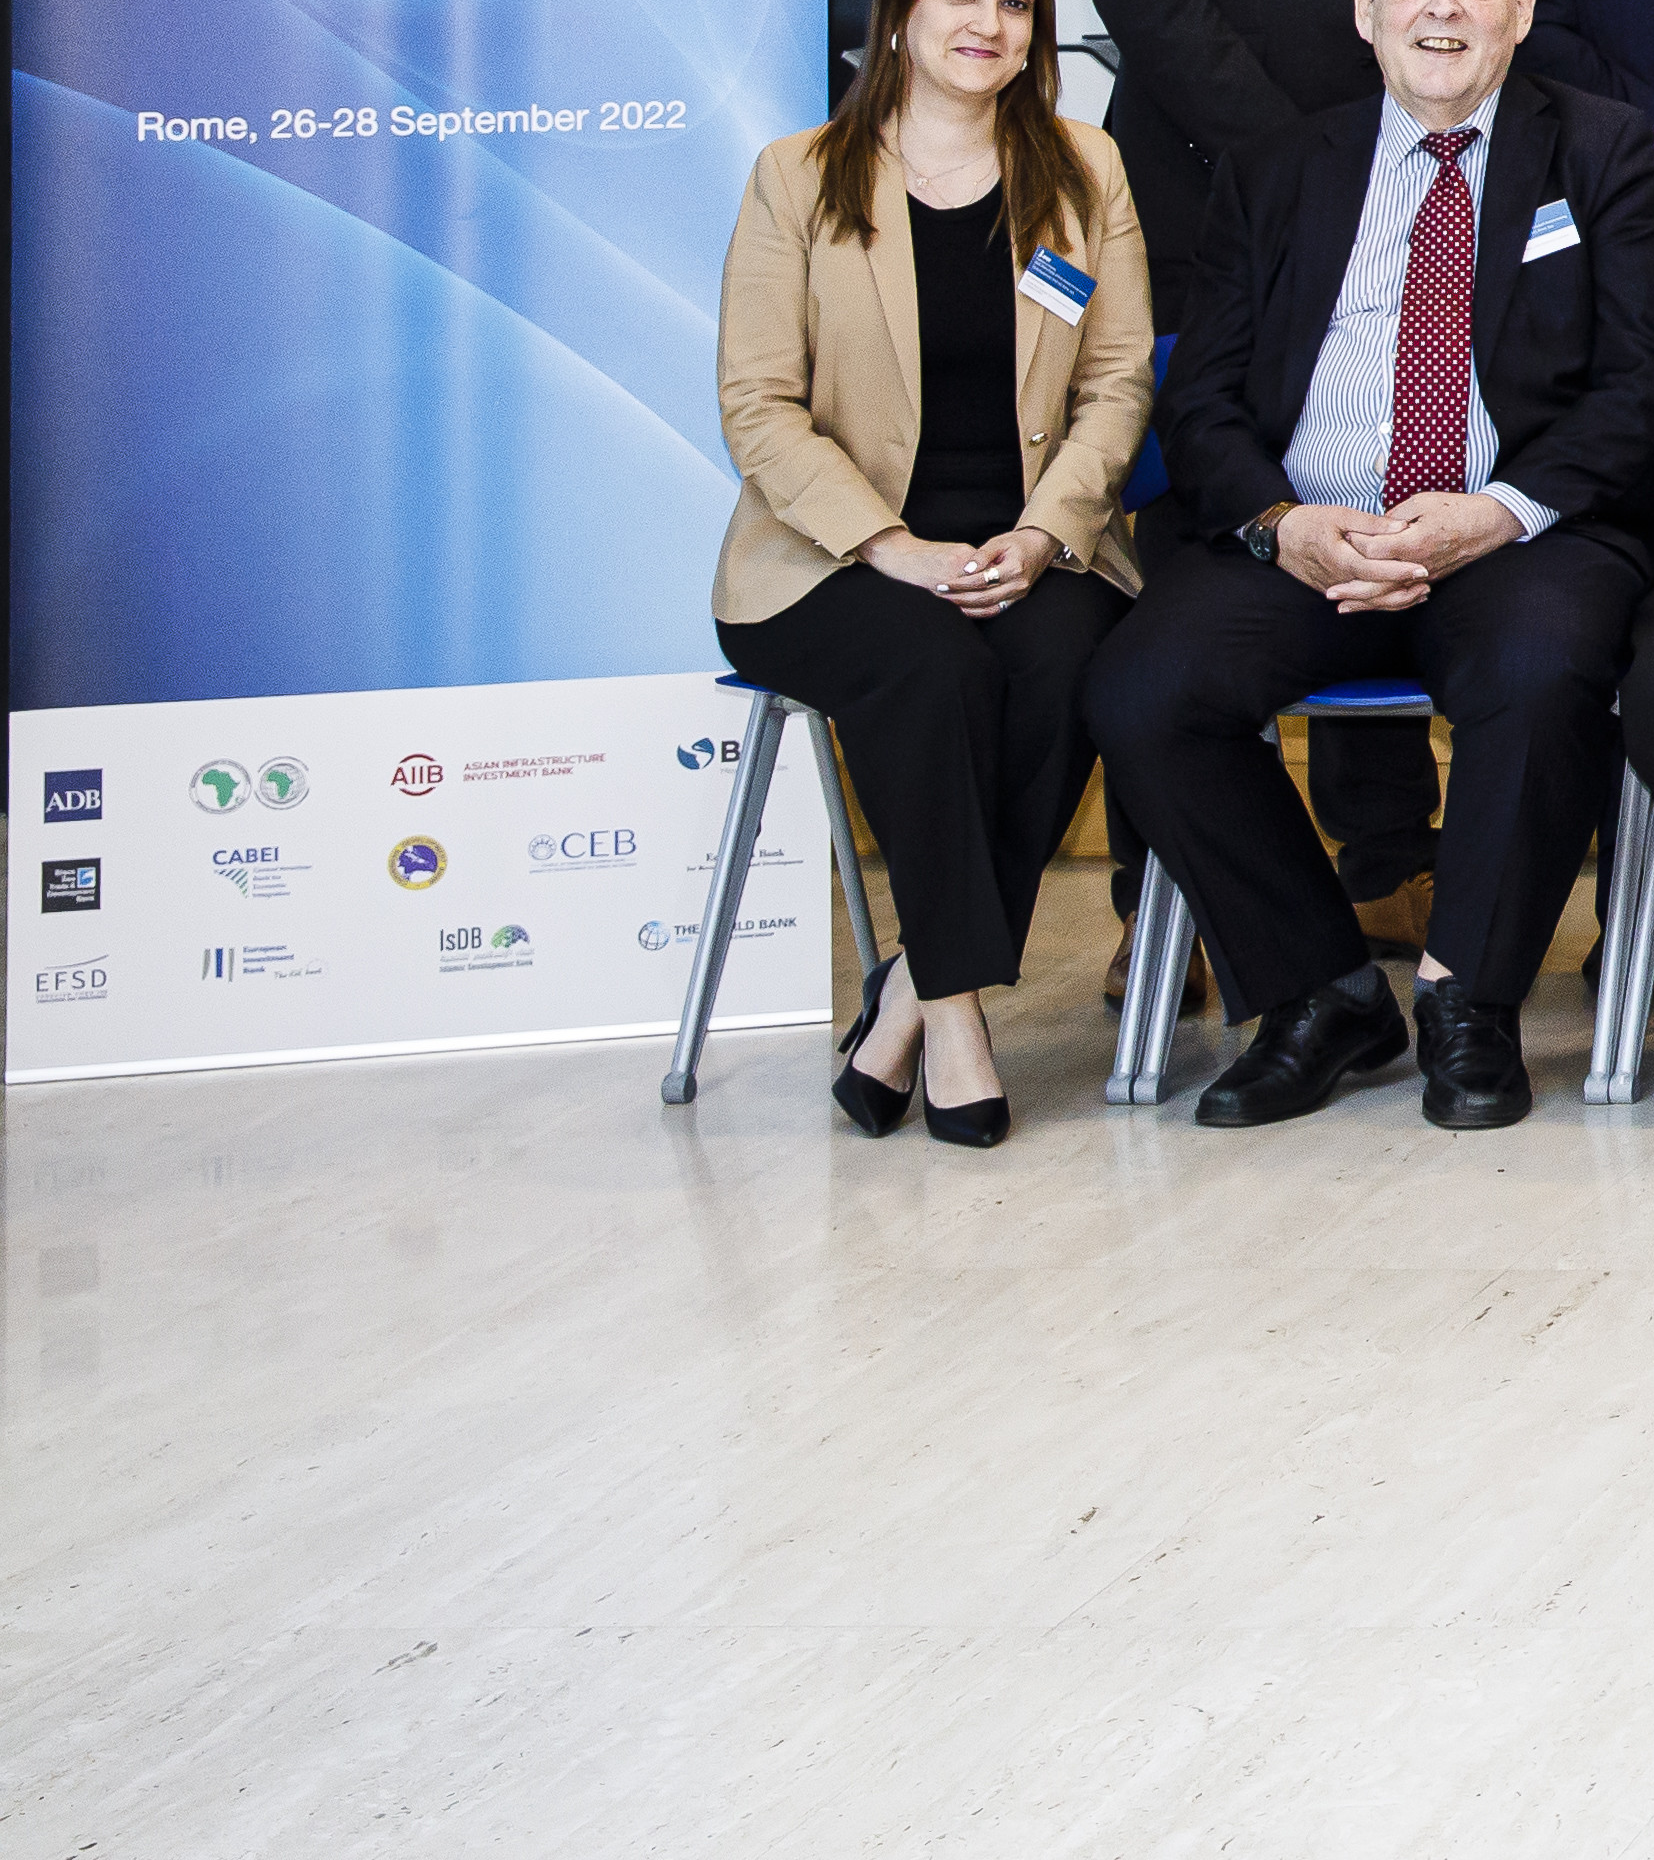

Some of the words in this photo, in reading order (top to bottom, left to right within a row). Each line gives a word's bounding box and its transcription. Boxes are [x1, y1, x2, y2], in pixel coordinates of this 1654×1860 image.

[137, 111, 258, 144] Rome,
[270, 107, 379, 139] 26-28
[390, 103, 590, 142] September
[599, 100, 686, 132] 2022
[463, 761, 500, 772] ASIAN
[502, 753, 607, 769] INFRASTRUCTURE
[463, 768, 537, 782] INVESTMENT
[542, 766, 574, 777] BANK
[390, 764, 444, 787] AIIB
[46, 790, 101, 813] ADB
[560, 829, 637, 858] CEB
[212, 846, 279, 865] CABEI
[674, 923, 700, 936] THE
[759, 916, 797, 930] BANK
[440, 926, 483, 951] IsDB
[36, 968, 107, 992] EFSD
